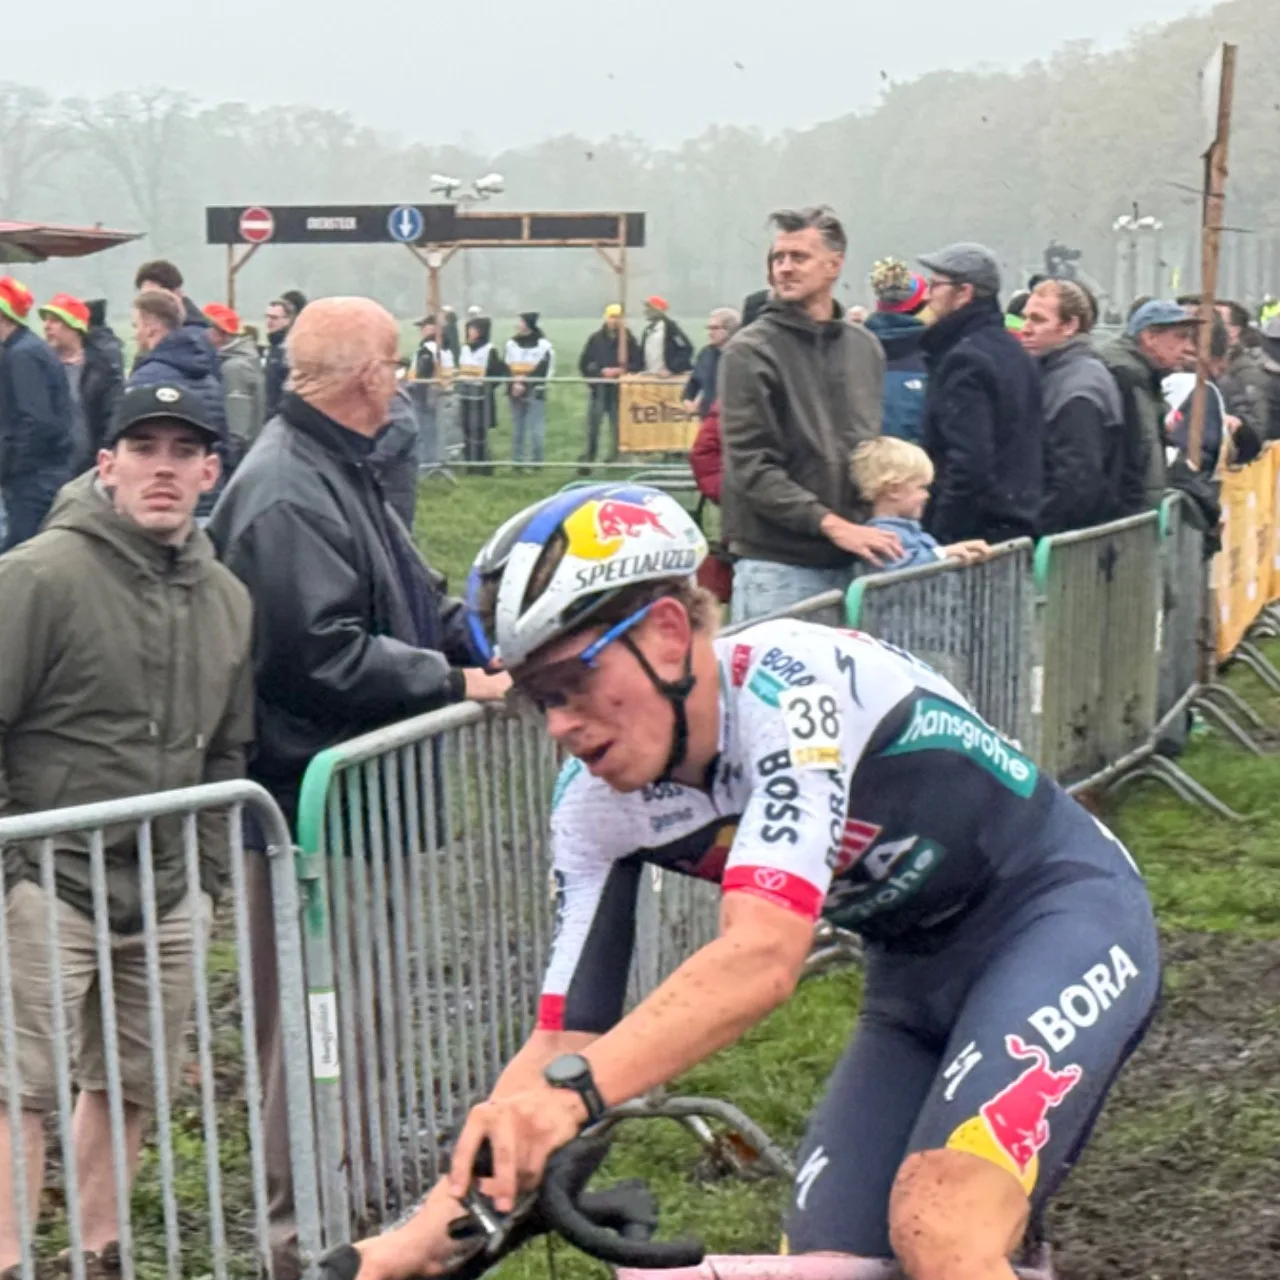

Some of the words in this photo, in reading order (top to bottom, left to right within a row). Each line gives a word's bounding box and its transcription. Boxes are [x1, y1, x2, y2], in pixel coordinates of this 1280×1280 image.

[572, 548, 698, 592] SPECIALIZED
[788, 695, 840, 740] 38
[899, 699, 1030, 781] hansgrohe
[757, 749, 800, 845] BOSS
[1028, 944, 1139, 1053] BORA
